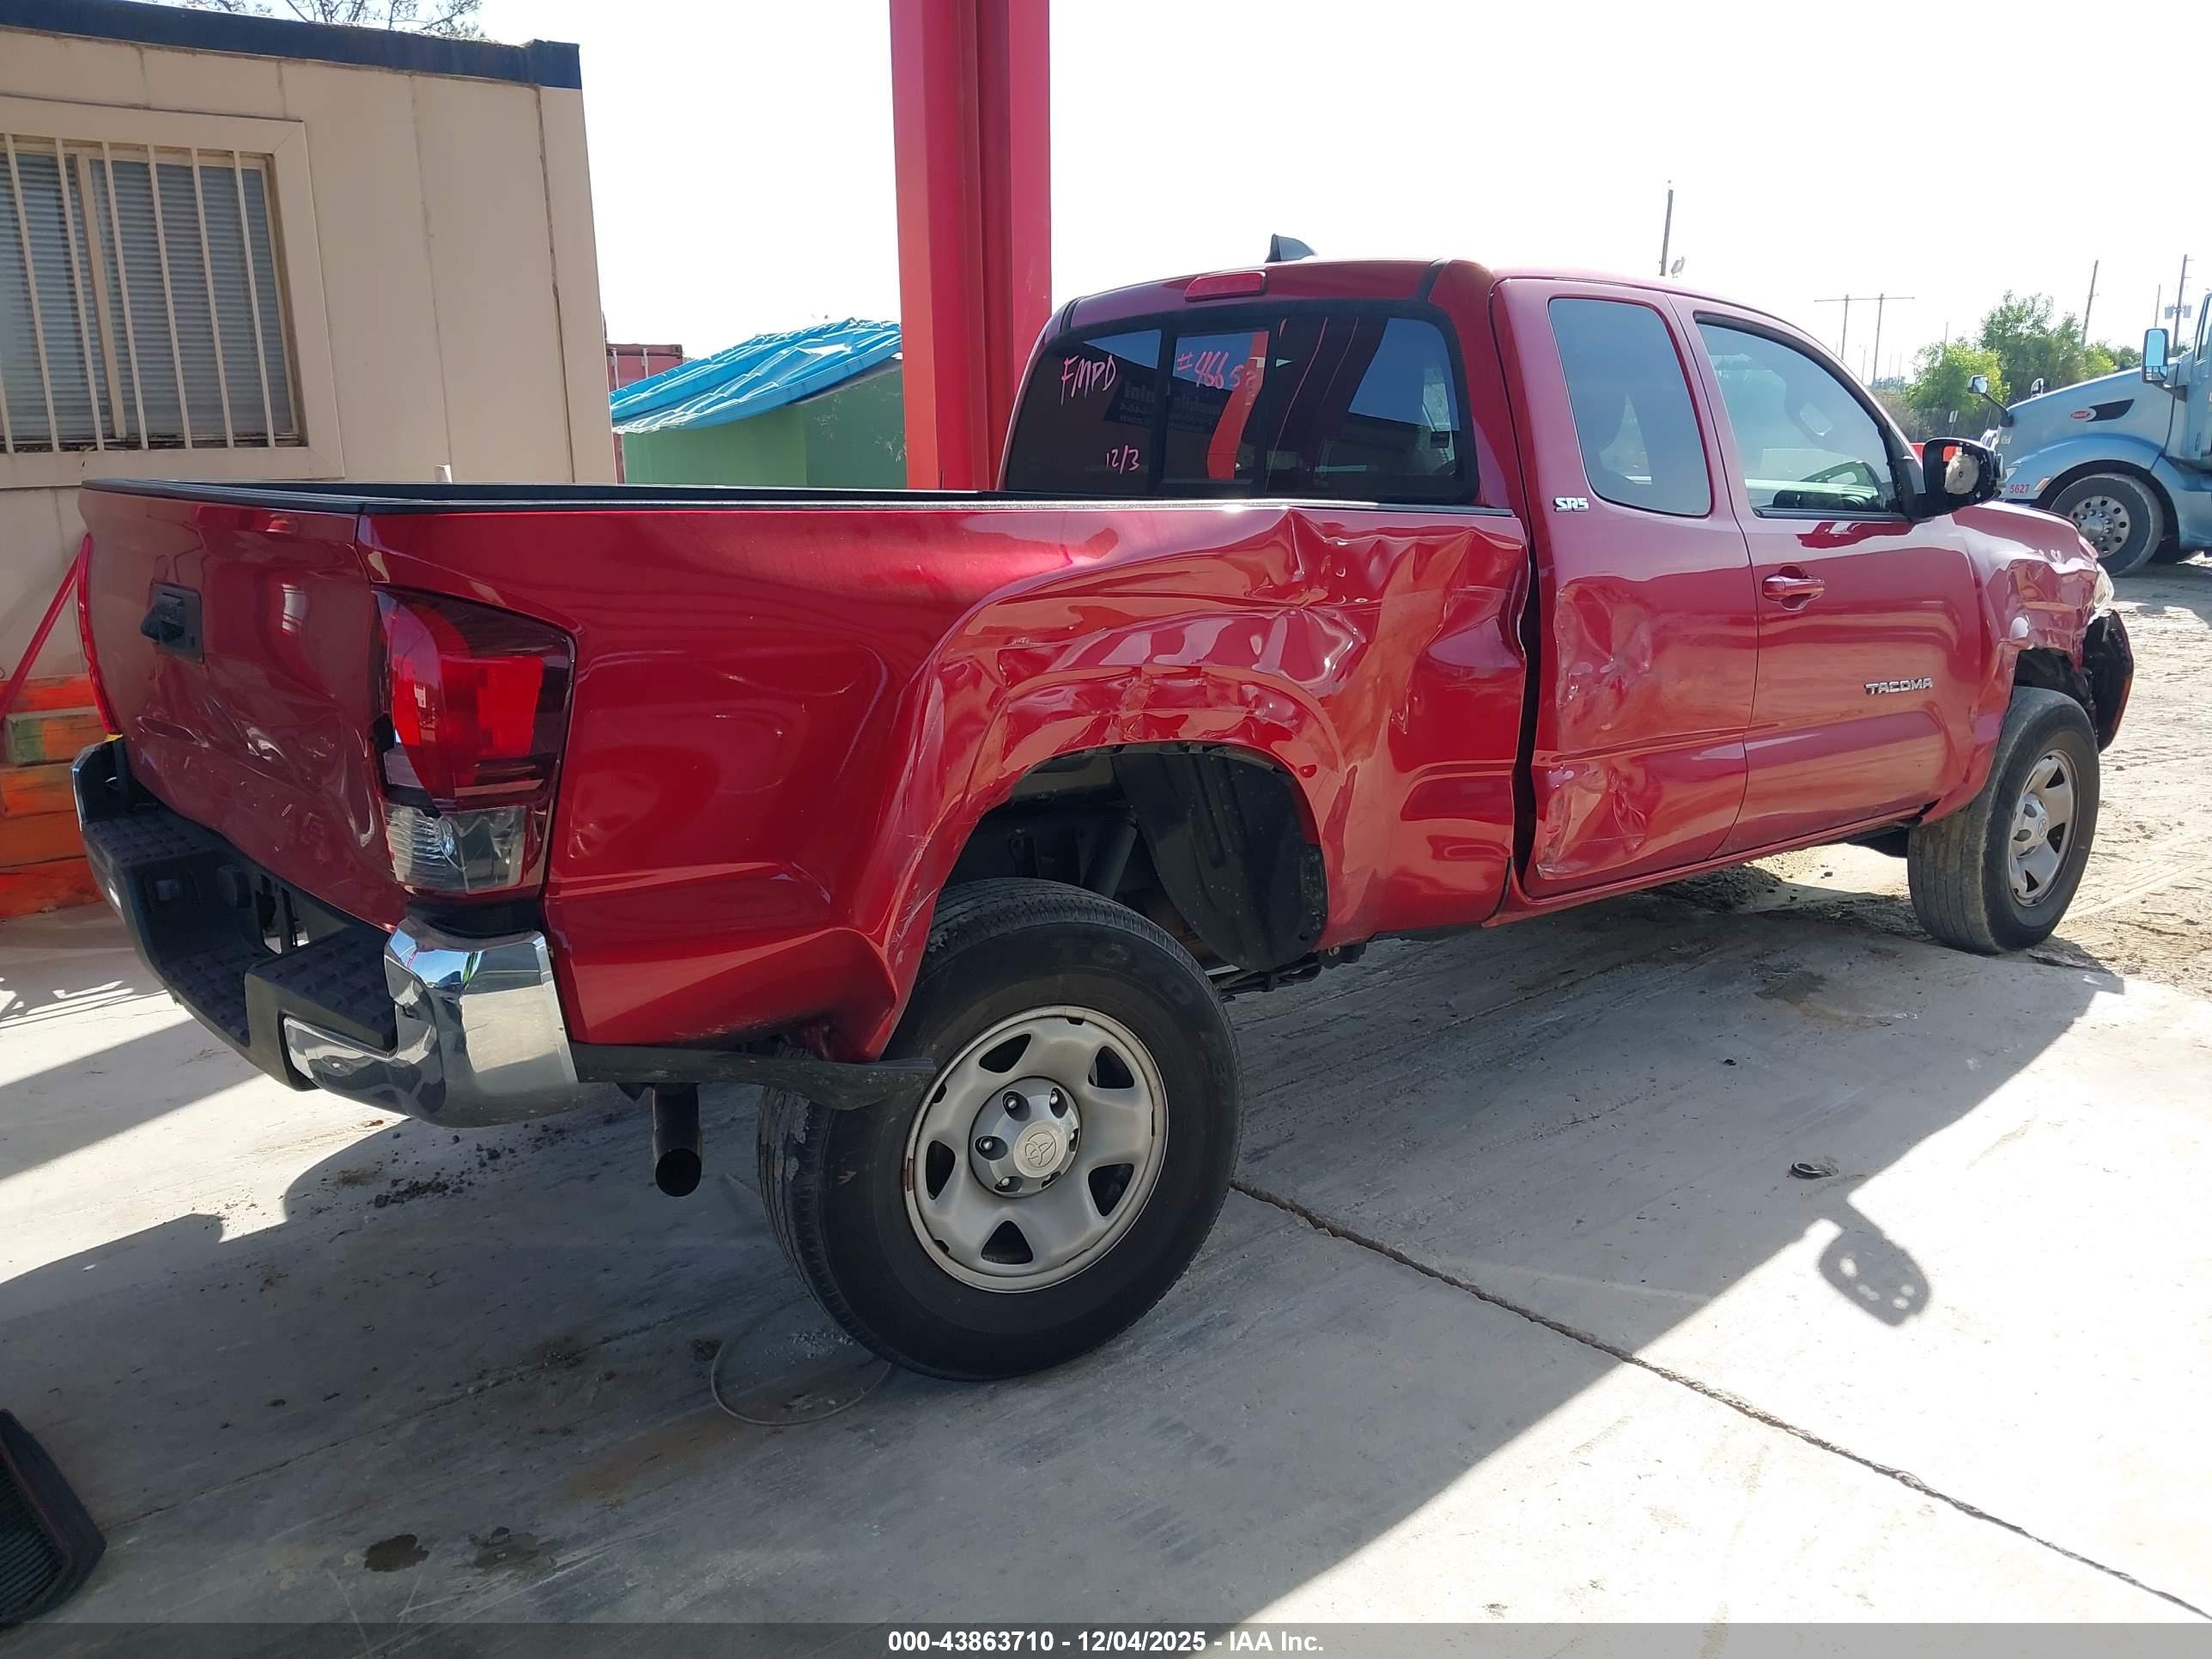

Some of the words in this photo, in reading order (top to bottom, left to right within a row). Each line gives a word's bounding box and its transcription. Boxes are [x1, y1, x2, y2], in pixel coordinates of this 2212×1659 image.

[1060, 355, 1116, 405] FMPD
[1106, 445, 1140, 474] 12/3
[2009, 483, 2031, 495] 5627
[1553, 497, 1589, 512] SR5
[1864, 678, 1933, 696] TACOMA
